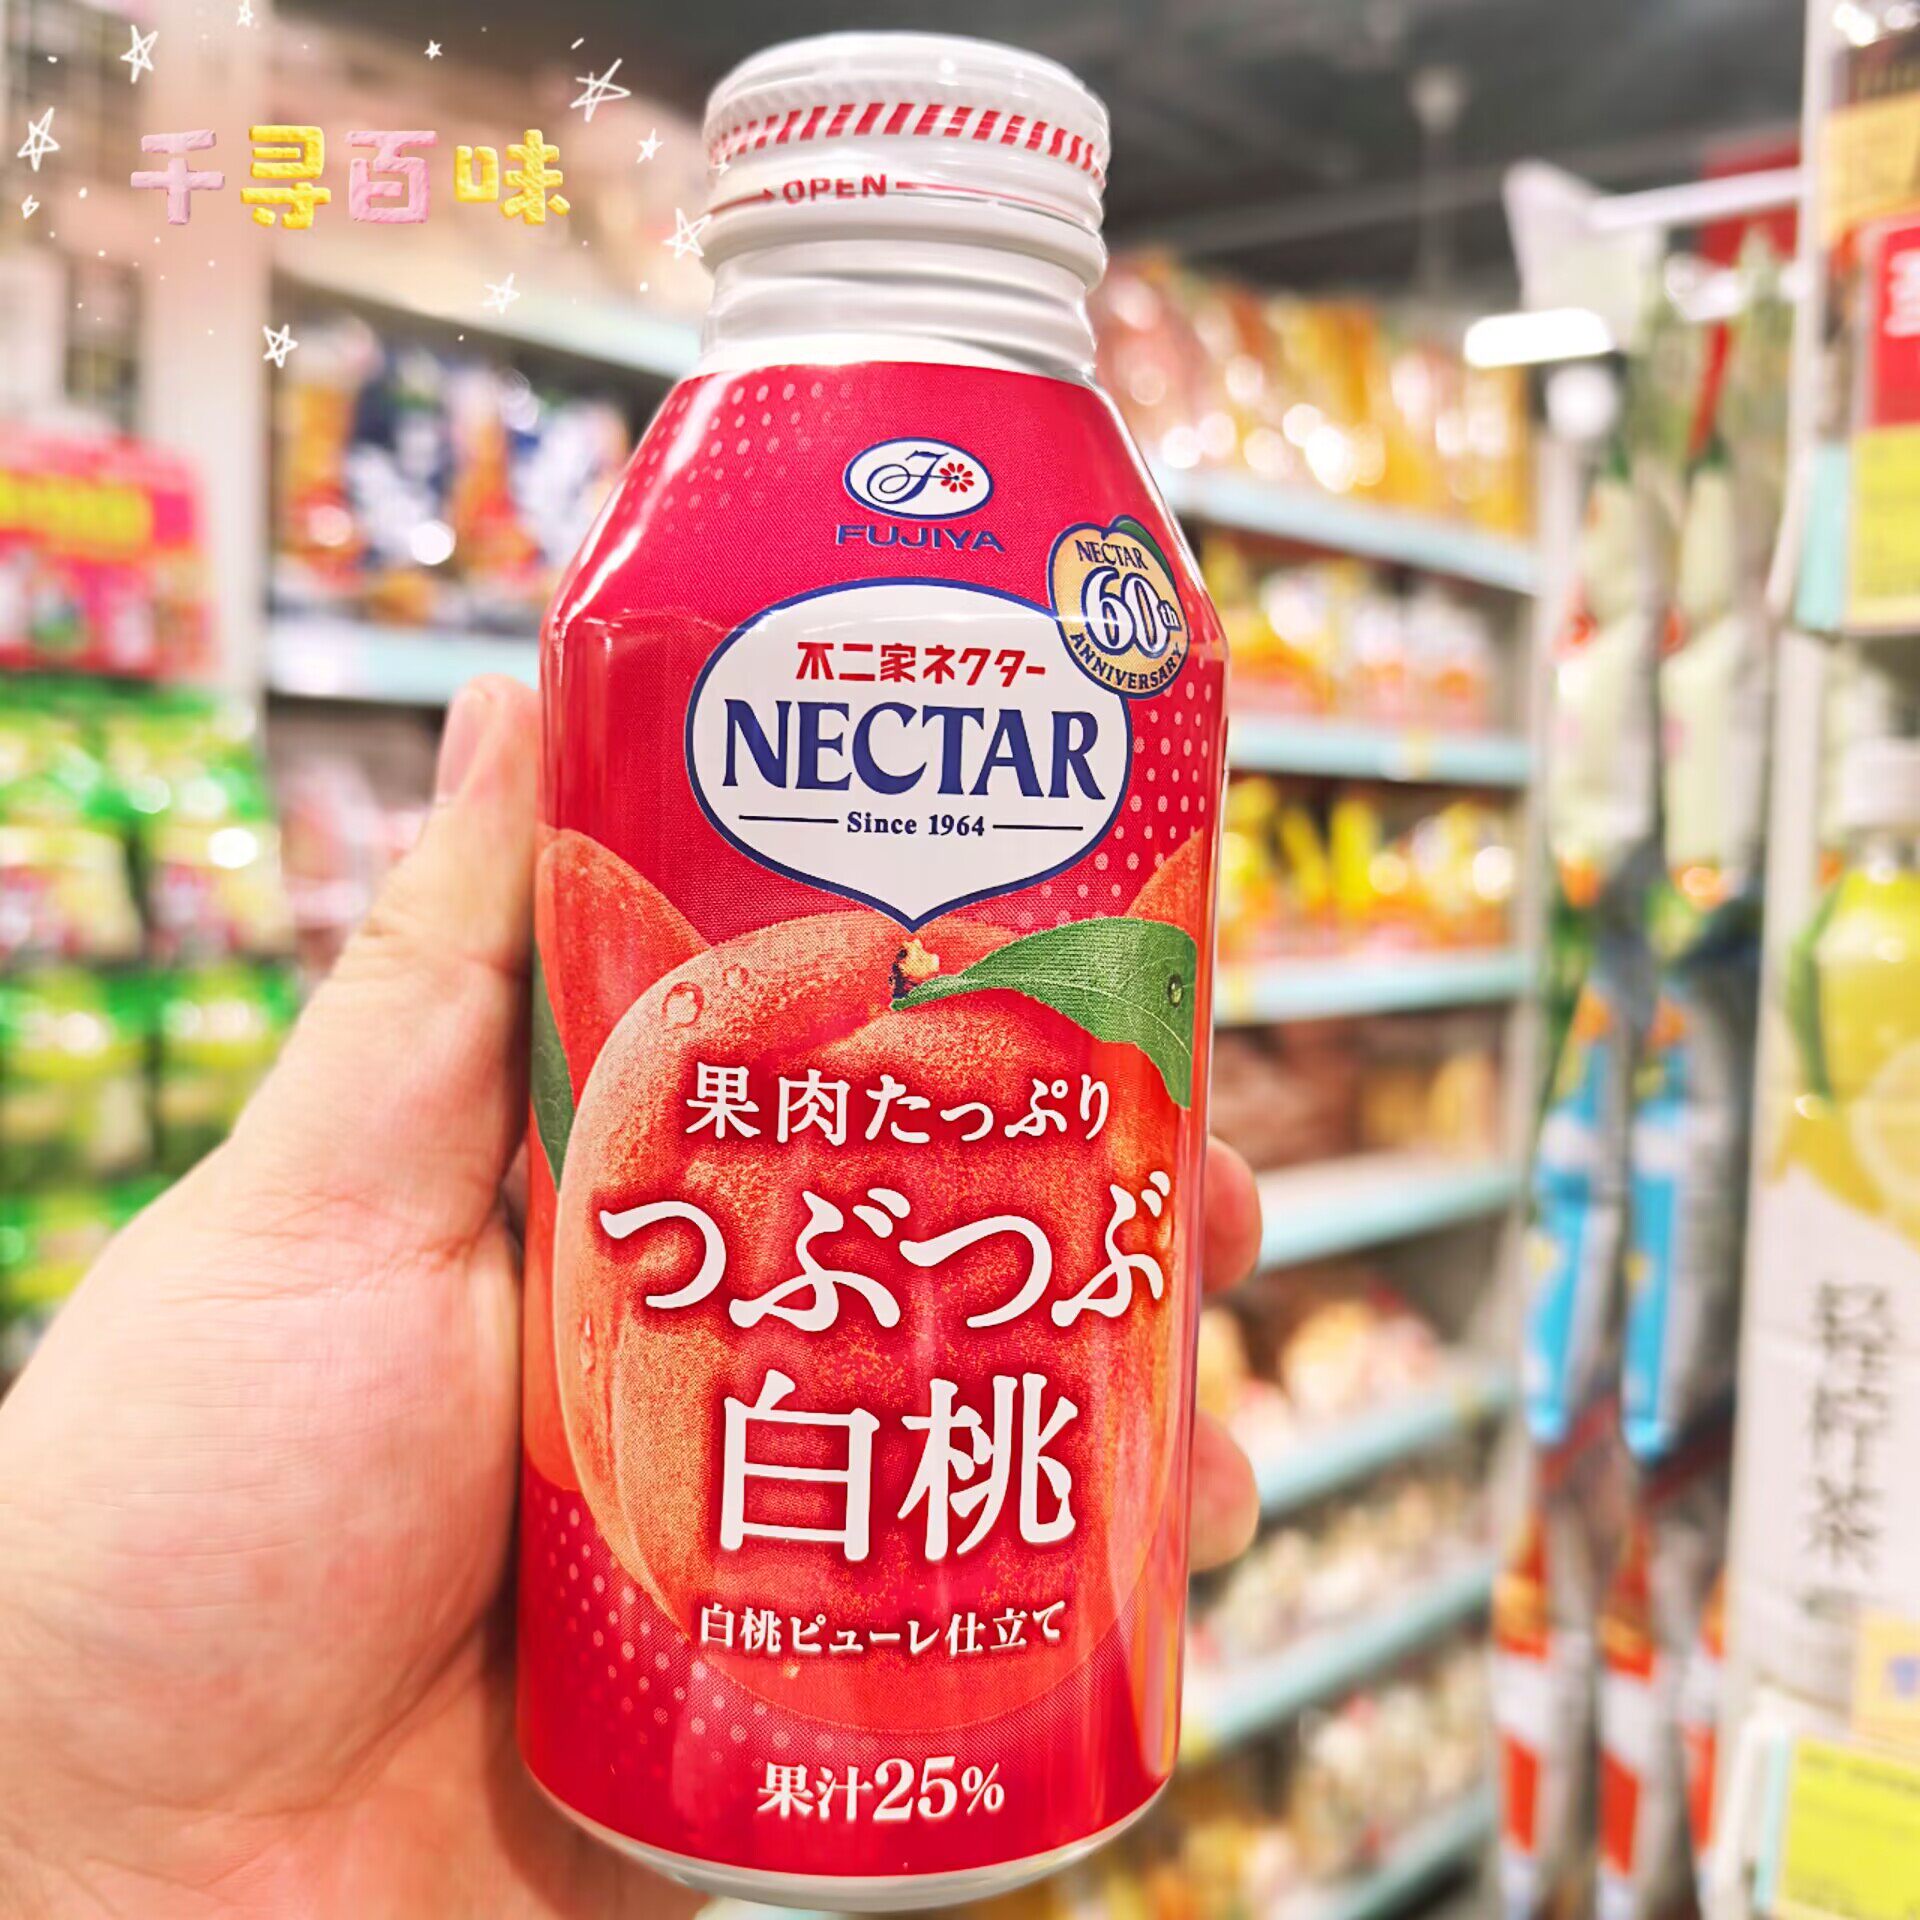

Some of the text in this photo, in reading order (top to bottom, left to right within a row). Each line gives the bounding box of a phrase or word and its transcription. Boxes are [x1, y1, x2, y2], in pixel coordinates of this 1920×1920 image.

[782, 173, 888, 205] OPEN
[836, 524, 1006, 552] FUJIYA
[1075, 540, 1148, 570] NECTAR
[796, 642, 1046, 688] 不二家ネクター
[1070, 632, 1184, 690] ANNIVERSARY
[722, 699, 1106, 800] NECTAR
[847, 812, 985, 838] Since 1964
[685, 1061, 1110, 1145] 果肉たっぷり
[600, 1170, 1171, 1332] つぶつぶ
[720, 1369, 1079, 1561] 白桃
[700, 1600, 1066, 1657] 白桃ピューレ仕立て
